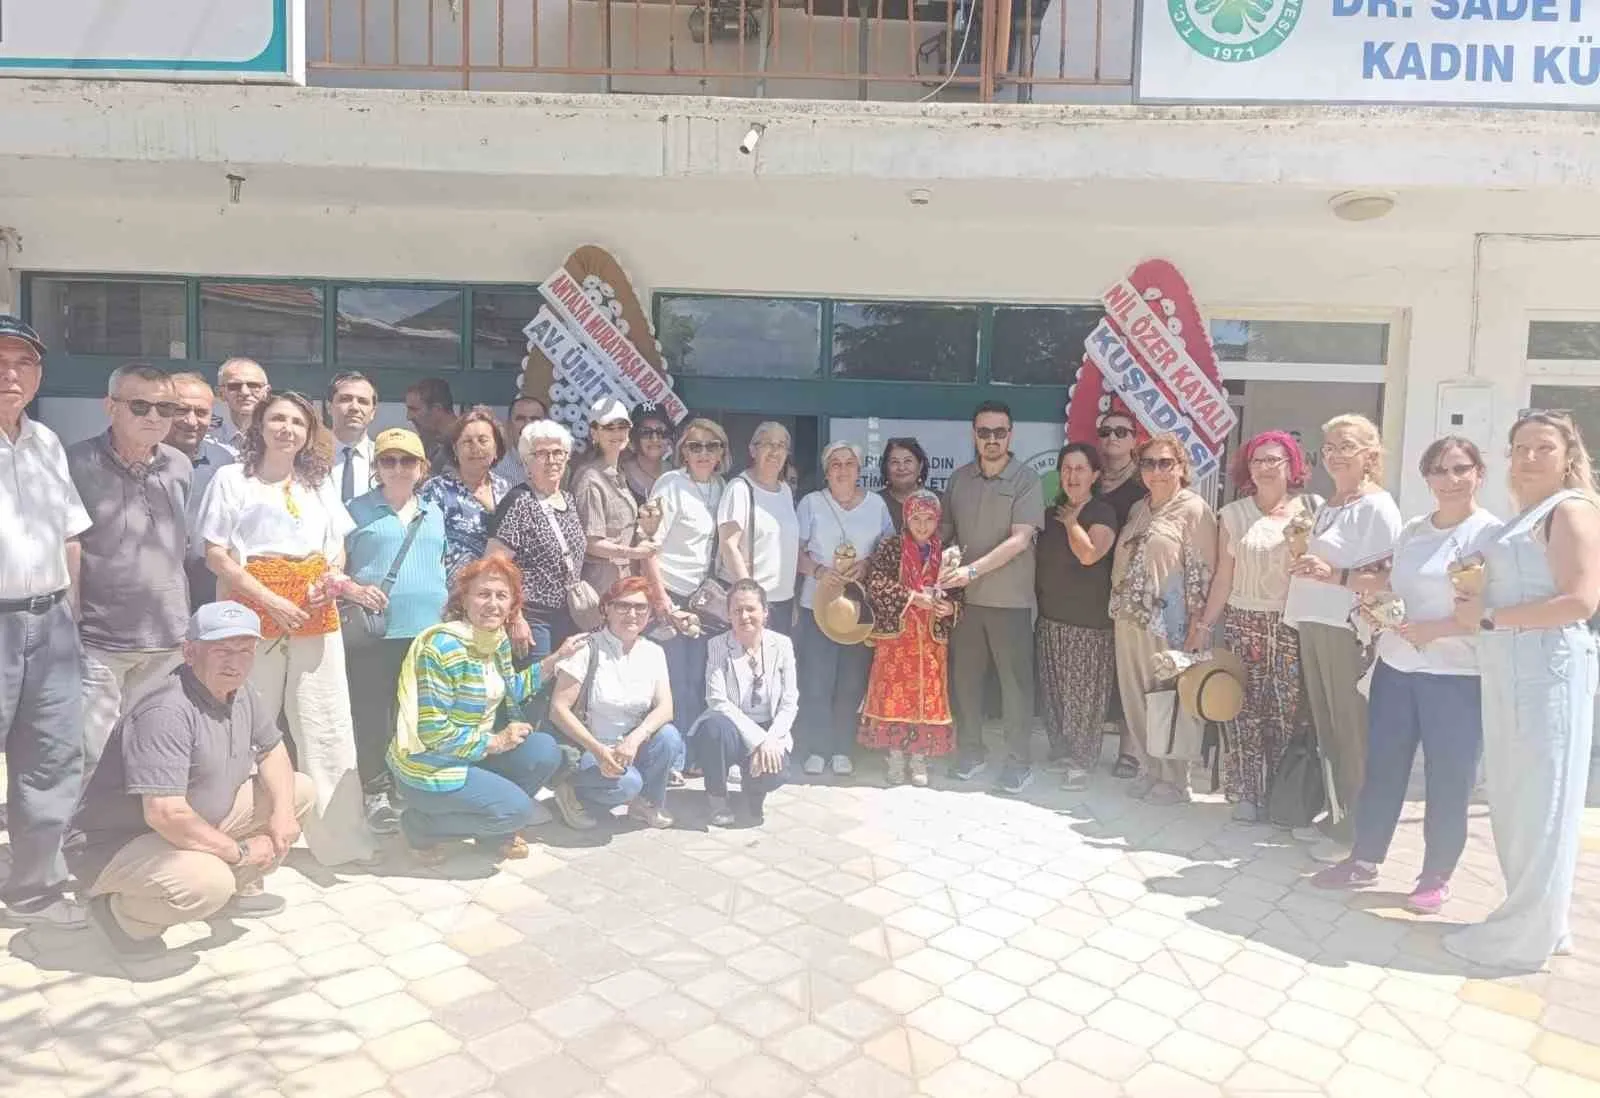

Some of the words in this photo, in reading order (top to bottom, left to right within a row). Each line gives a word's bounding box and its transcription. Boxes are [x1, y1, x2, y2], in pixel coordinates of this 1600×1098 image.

[1213, 46, 1256, 60] 1971
[1362, 41, 1514, 82] KADIN
[1533, 36, 1600, 85] KÜ
[549, 274, 594, 327] ANTALYA
[530, 319, 564, 354] AV.
[561, 346, 613, 401] ÜMİT
[1104, 284, 1136, 322] NİL
[1130, 314, 1178, 372] ÖZER
[1170, 364, 1232, 438] KAYALI
[1092, 327, 1216, 477] KUŞADASI
